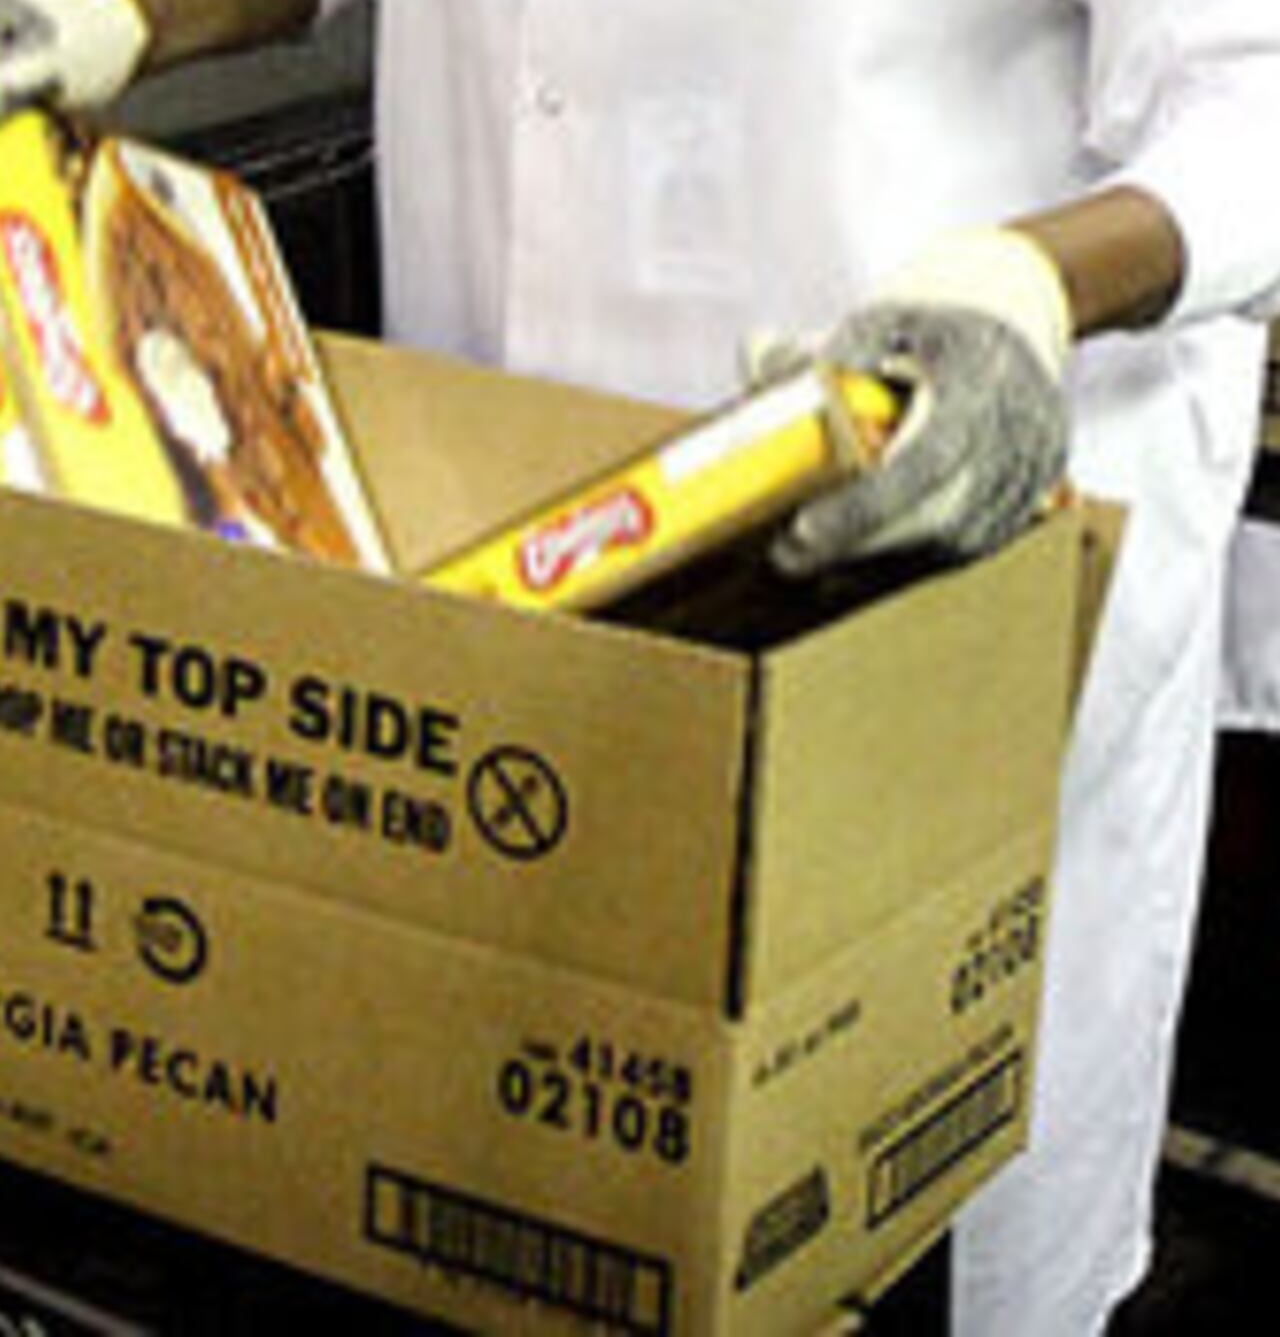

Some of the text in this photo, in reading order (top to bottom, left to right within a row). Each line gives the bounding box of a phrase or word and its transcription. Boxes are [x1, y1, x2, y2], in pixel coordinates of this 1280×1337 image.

[4, 597, 107, 679] MY
[128, 632, 267, 717] TOP
[288, 674, 461, 778] SIDE
[51, 697, 97, 755] ME
[104, 713, 146, 769] OR
[156, 727, 256, 798] STACK
[266, 756, 318, 817] ME
[381, 789, 453, 853] END
[111, 1027, 277, 1124] PECAN
[499, 1058, 691, 1166] 02108
